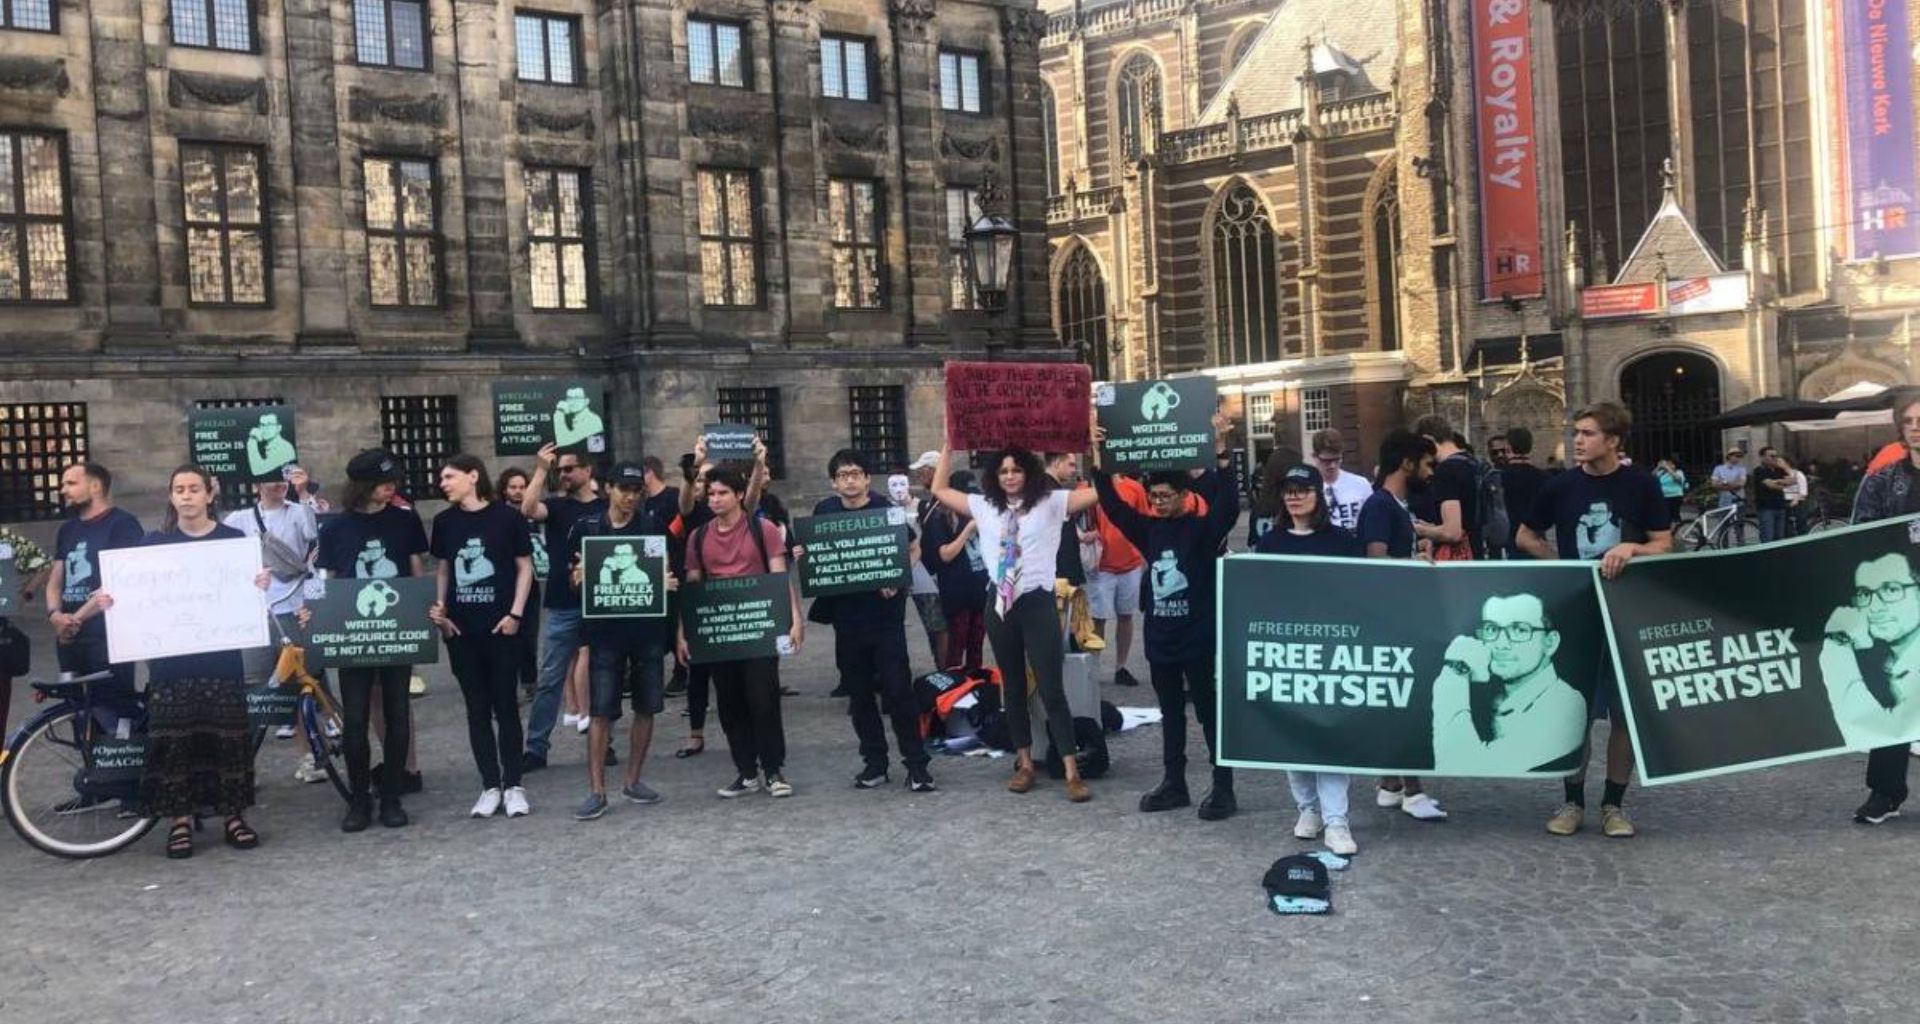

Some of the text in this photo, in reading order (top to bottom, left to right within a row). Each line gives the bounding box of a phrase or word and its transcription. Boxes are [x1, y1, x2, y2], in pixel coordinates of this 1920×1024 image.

[1870, 23, 1889, 89] Nieuwe
[1485, 0, 1529, 188] & Royalty
[1873, 95, 1893, 135] Kerk
[499, 403, 524, 412] FREE
[500, 413, 551, 422] SPEECH IS
[501, 424, 534, 433] UNDER
[1131, 422, 1178, 434] WRITING
[194, 431, 219, 440] FREE
[1105, 433, 1208, 449] OPEN-SOURCE CODE
[195, 441, 244, 451] SPEECH IS
[197, 453, 229, 462] UNDER
[1116, 447, 1198, 461] IS NOT A CRIME!
[815, 515, 886, 533] #FREEALEX
[806, 534, 896, 552] WILL YOU ARREST
[808, 545, 898, 563] A GUN MAKER FOR
[815, 558, 894, 574] FACILITATING A
[808, 568, 904, 587] PUBLIC SHOOTING?
[594, 583, 653, 595] FREE ALEX
[594, 595, 654, 607] PERTSEV
[696, 600, 772, 614] WILL YOU ARREST
[709, 614, 734, 623] KNIFE
[736, 610, 767, 620] MAKER
[345, 619, 398, 630] WRITING
[697, 620, 775, 635] FOR FACILITATING
[1248, 621, 1360, 638] #FREEPERTSEV
[1639, 618, 1714, 641] #FREEALEX
[311, 630, 429, 643] OPEN-SOURCE CODE
[715, 631, 764, 643] STABBING?
[324, 643, 419, 656] IS NOT A CRIME!
[1247, 640, 1415, 673] FREE ALEX
[1643, 627, 1798, 676] FREE ALEX
[1246, 670, 1415, 708] PERTSEV
[1652, 657, 1802, 711] PERTSEV
